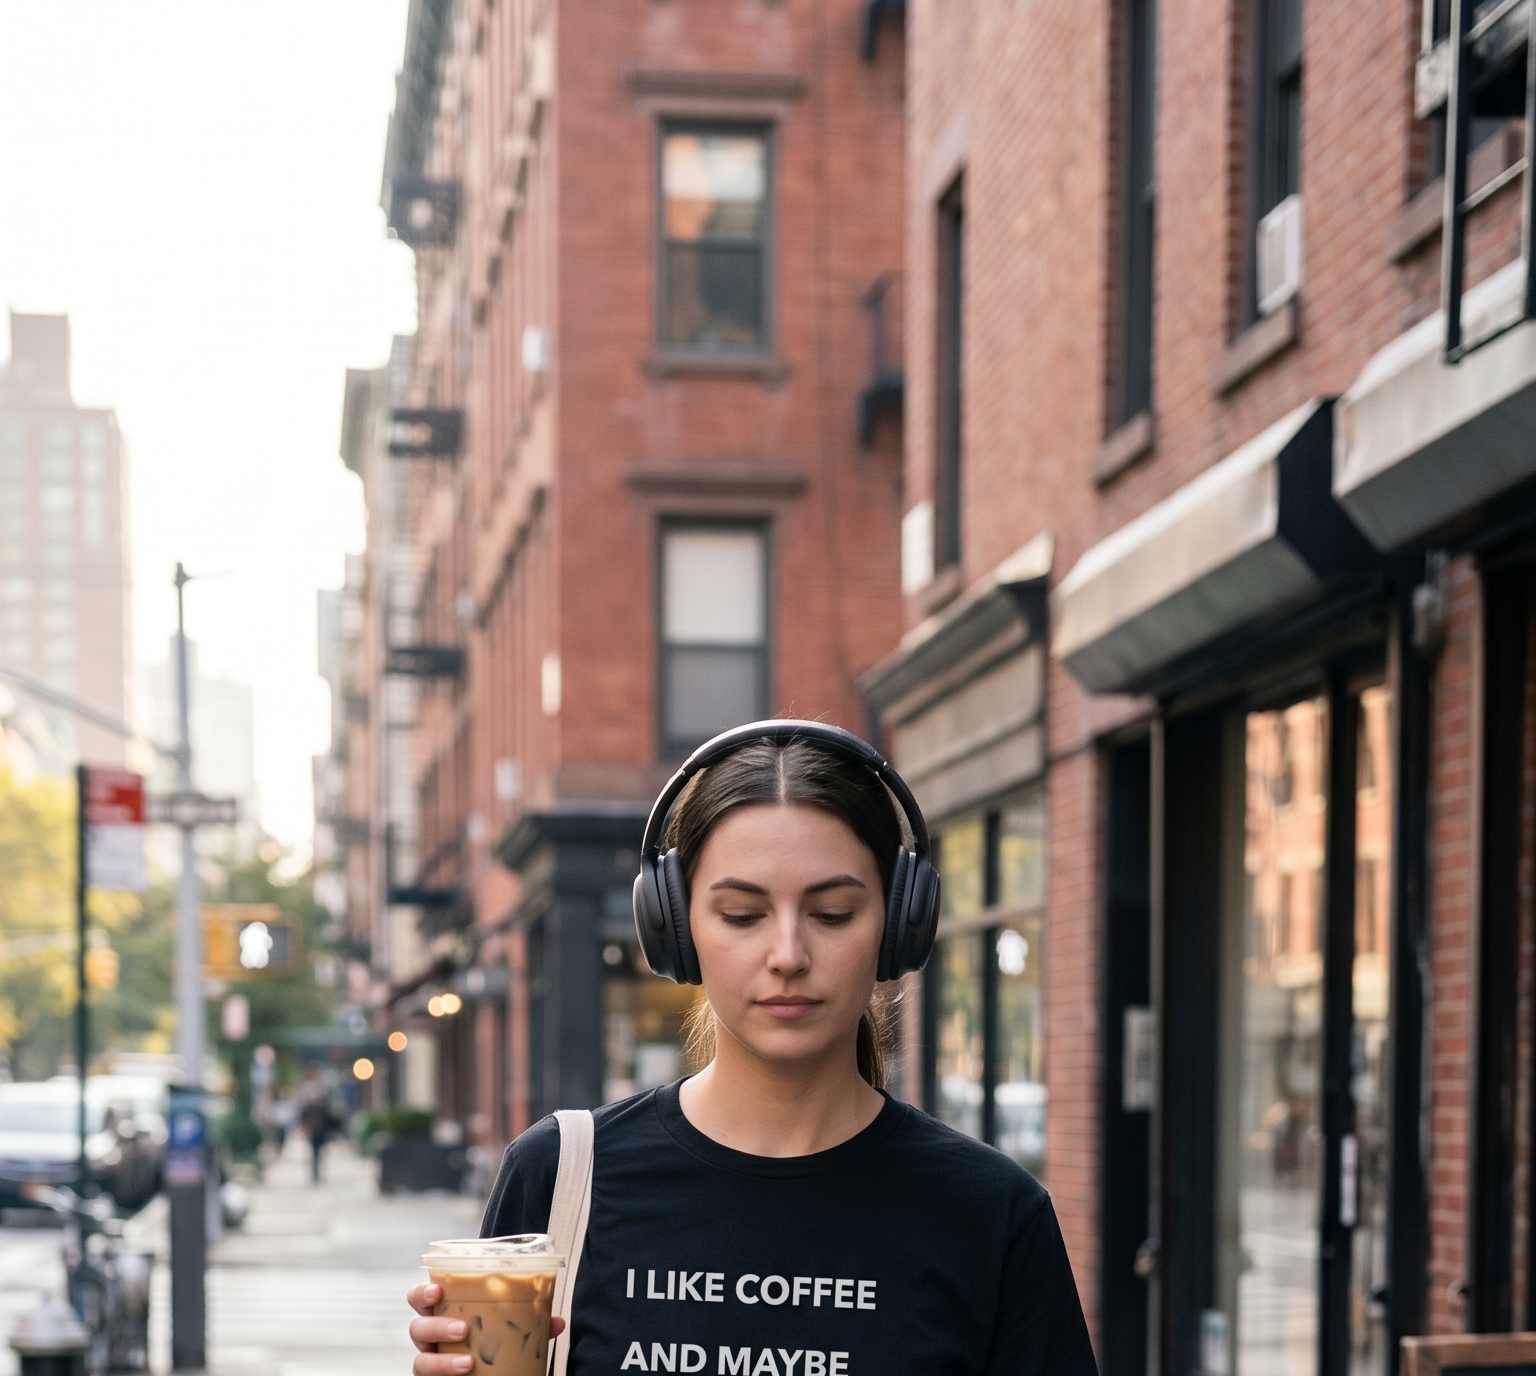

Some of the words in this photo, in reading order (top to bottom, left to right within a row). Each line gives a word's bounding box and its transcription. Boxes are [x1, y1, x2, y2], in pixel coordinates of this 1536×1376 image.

[626, 1268, 636, 1299] I
[646, 1269, 725, 1303] LIKE
[735, 1273, 877, 1310] COFFEE
[619, 1341, 707, 1373] AND
